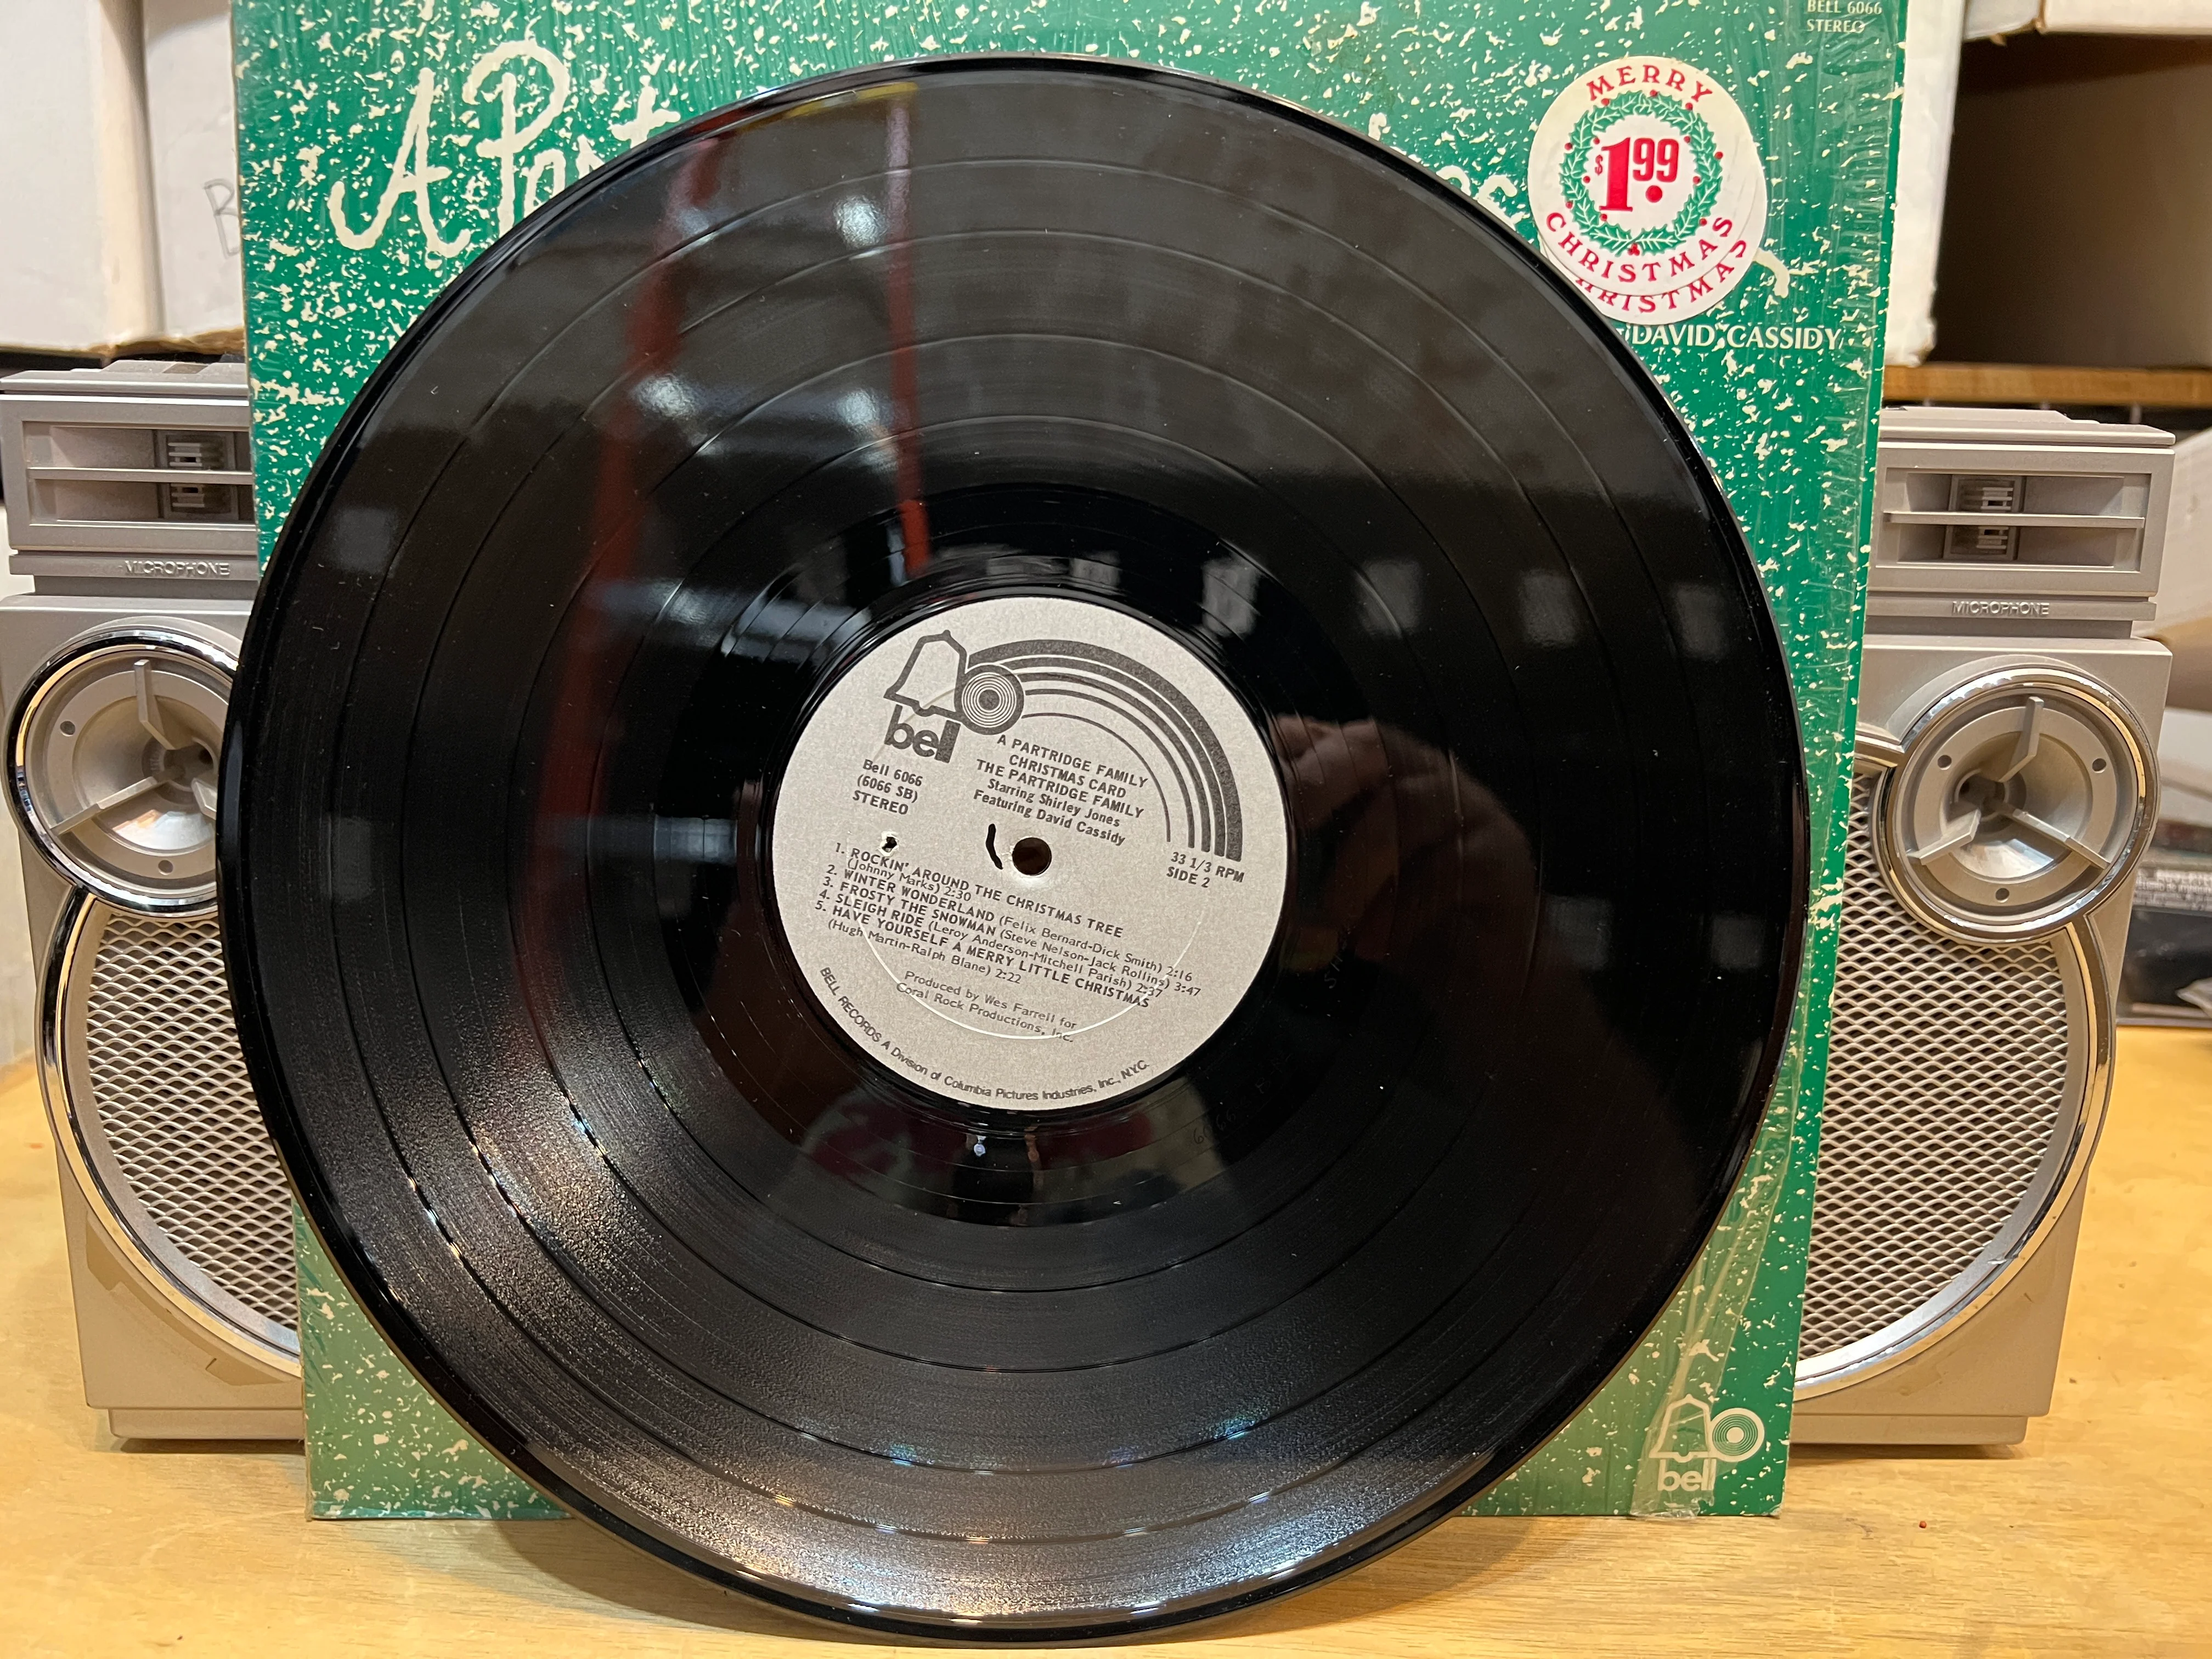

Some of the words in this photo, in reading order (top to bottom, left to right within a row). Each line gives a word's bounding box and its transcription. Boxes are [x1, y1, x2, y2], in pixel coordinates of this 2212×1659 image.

[1807, 0, 1842, 13] BELL
[1847, 1, 1882, 15] 6066
[1807, 19, 1865, 33] STEREO
[1587, 64, 1713, 103] MERRY
[1546, 212, 1733, 283] CHRISTMAS
[1632, 324, 1715, 346] DAVID
[1726, 325, 1842, 349] CASSIDY
[125, 560, 230, 576] MICROPHONE
[1951, 600, 2051, 617] MICROPHONE
[862, 759, 890, 776] Bell
[893, 769, 923, 787] 6066
[996, 734, 1006, 746] A
[1011, 738, 1092, 772] PARTRIDGE
[1096, 764, 1148, 788] FAMILY
[1009, 754, 1085, 786] CHRISTMAS
[1088, 778, 1126, 798] CARD
[852, 789, 909, 815] STEREO
[857, 774, 892, 794] (6066
[895, 786, 918, 804] SB)
[977, 758, 1005, 777] THE
[1008, 769, 1089, 803] PARTRIDGE
[1092, 794, 1144, 819] FAMILY
[987, 778, 1036, 804] Starring
[1039, 793, 1082, 817] Shirley
[1084, 808, 1120, 827] Jones
[973, 789, 1033, 819] Featuring
[1036, 809, 1073, 829] David
[1076, 821, 1126, 847] Cassidy
[847, 857, 895, 880] (Johnny
[899, 872, 940, 894] Marks)
[943, 886, 972, 902] 2:30
[1166, 866, 1199, 885] SIDE
[1201, 877, 1210, 888] 2
[1170, 851, 1187, 865] 33
[1189, 857, 1212, 873] 1/3
[1215, 865, 1245, 883] RPM
[836, 842, 845, 854] 1.
[911, 867, 969, 890] AROUND
[975, 884, 1002, 901] THE
[1006, 894, 1082, 925] CHRISTMAS
[1087, 918, 1124, 938] TREE
[819, 889, 830, 900] 4.
[835, 893, 888, 917] SLEIGH
[890, 910, 924, 928] RIDE
[928, 920, 969, 941] (Leroy
[971, 934, 1084, 974] Anderson-Mitchell
[1087, 968, 1132, 991] Parish)
[1135, 983, 1163, 998] 2:37
[822, 876, 833, 888] 3.
[839, 881, 895, 906] FROSTY
[900, 899, 928, 916] THE
[931, 909, 997, 936] SNOWMAN
[1000, 929, 1037, 947] (Steve
[1041, 941, 1117, 972] Nelson-Jack
[1121, 965, 1170, 990] Rollins)
[1173, 981, 1201, 996] 3:47
[826, 864, 837, 876] 2.
[844, 868, 896, 893] WINTER
[901, 885, 995, 922] WONDERLAND
[999, 915, 1037, 934] (Felix
[1041, 927, 1120, 960] Bernard-Dick
[1124, 953, 1163, 974] Smith)
[1166, 966, 1193, 982] 2:16
[815, 900, 826, 912] 5.
[832, 905, 871, 925] HAVE
[877, 918, 949, 946] YOURSELF
[952, 941, 961, 952] A
[966, 945, 1015, 967] MERRY
[1018, 960, 1071, 984] LITTLE
[1075, 978, 1150, 1008] CHRISTMAS
[828, 918, 864, 937] (Hugh
[867, 930, 946, 961] Martin-Ralph
[951, 955, 991, 977] Blane)
[995, 968, 1022, 984] 2:22
[896, 983, 929, 999] Coral
[933, 993, 964, 1010] Rock
[904, 970, 962, 996] Produced
[965, 989, 980, 1002] by
[985, 994, 1007, 1009] Wes
[1013, 1002, 1056, 1023] Farrell
[1059, 1017, 1077, 1029] for
[820, 967, 839, 996] BELL
[837, 996, 882, 1042] RECORDS
[881, 1041, 891, 1050] A
[890, 1047, 928, 1075] Division
[930, 1072, 943, 1081] of
[944, 1076, 992, 1097] Columbia
[996, 1088, 1039, 1101] Pictures
